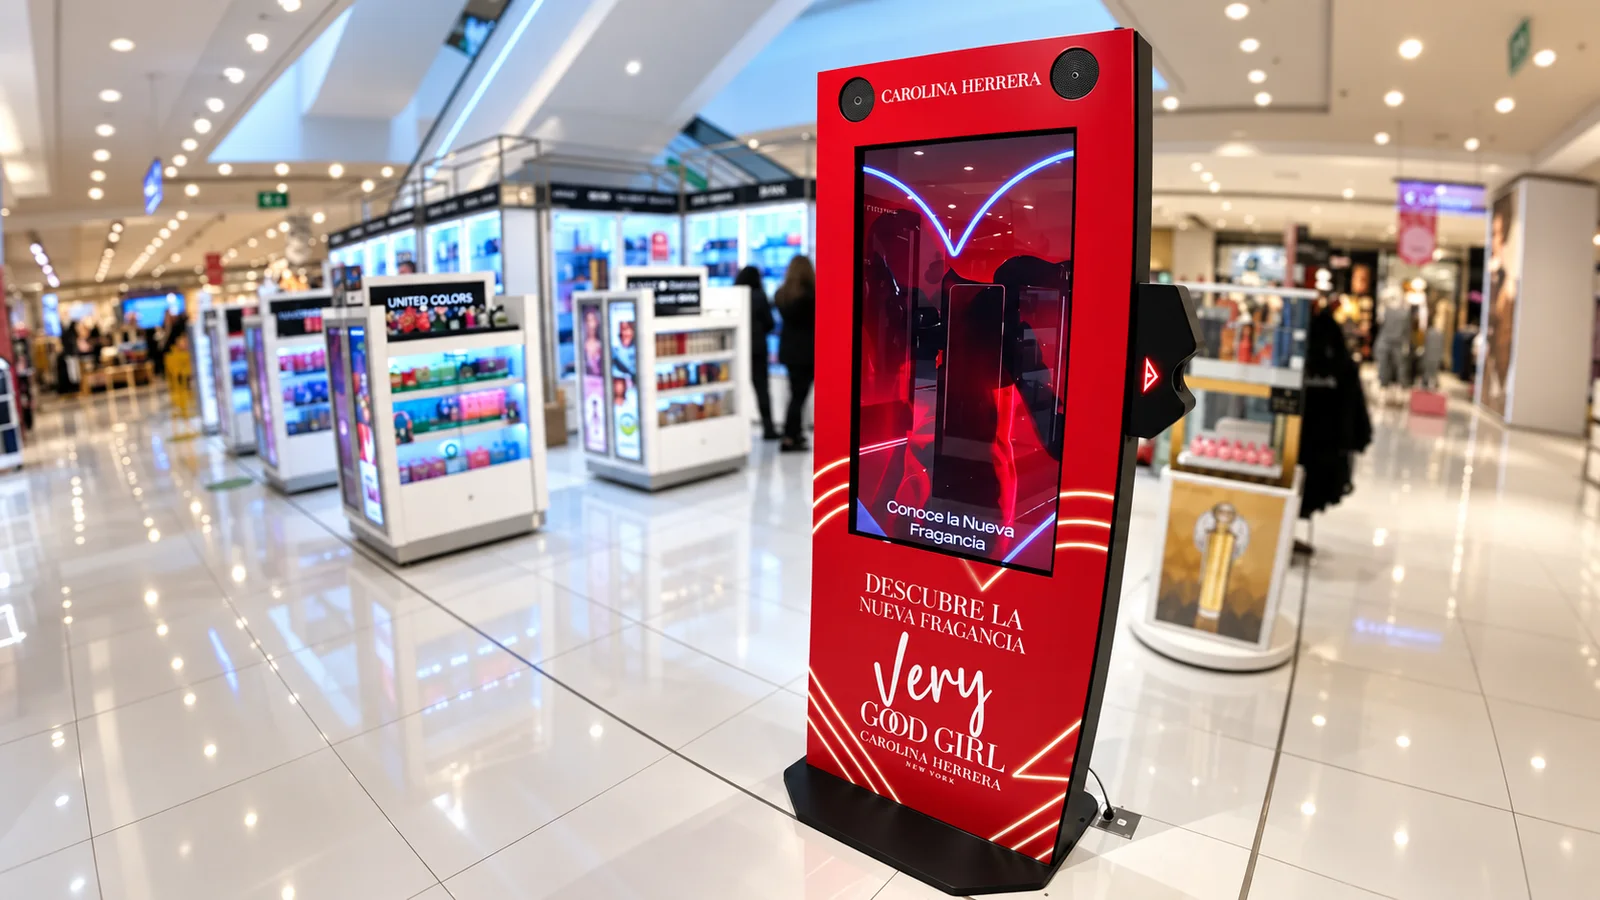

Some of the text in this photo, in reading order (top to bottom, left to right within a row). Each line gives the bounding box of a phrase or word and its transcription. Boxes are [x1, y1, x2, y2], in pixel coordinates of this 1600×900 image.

[881, 71, 1042, 104] CAROLINA HERRERA
[387, 292, 473, 308] UNITED COLORS
[886, 500, 1015, 539] Conoce la Nueva
[909, 522, 986, 551] Fragancia
[859, 596, 1026, 655] NUEVA FRAGANCIA
[864, 572, 1024, 631] DESCUBRE LA
[873, 631, 993, 738] Very
[860, 700, 1006, 773] GOOD GIRL
[860, 730, 1001, 791] CAROLINA HERRERA
[905, 761, 955, 785] NEW YORK
